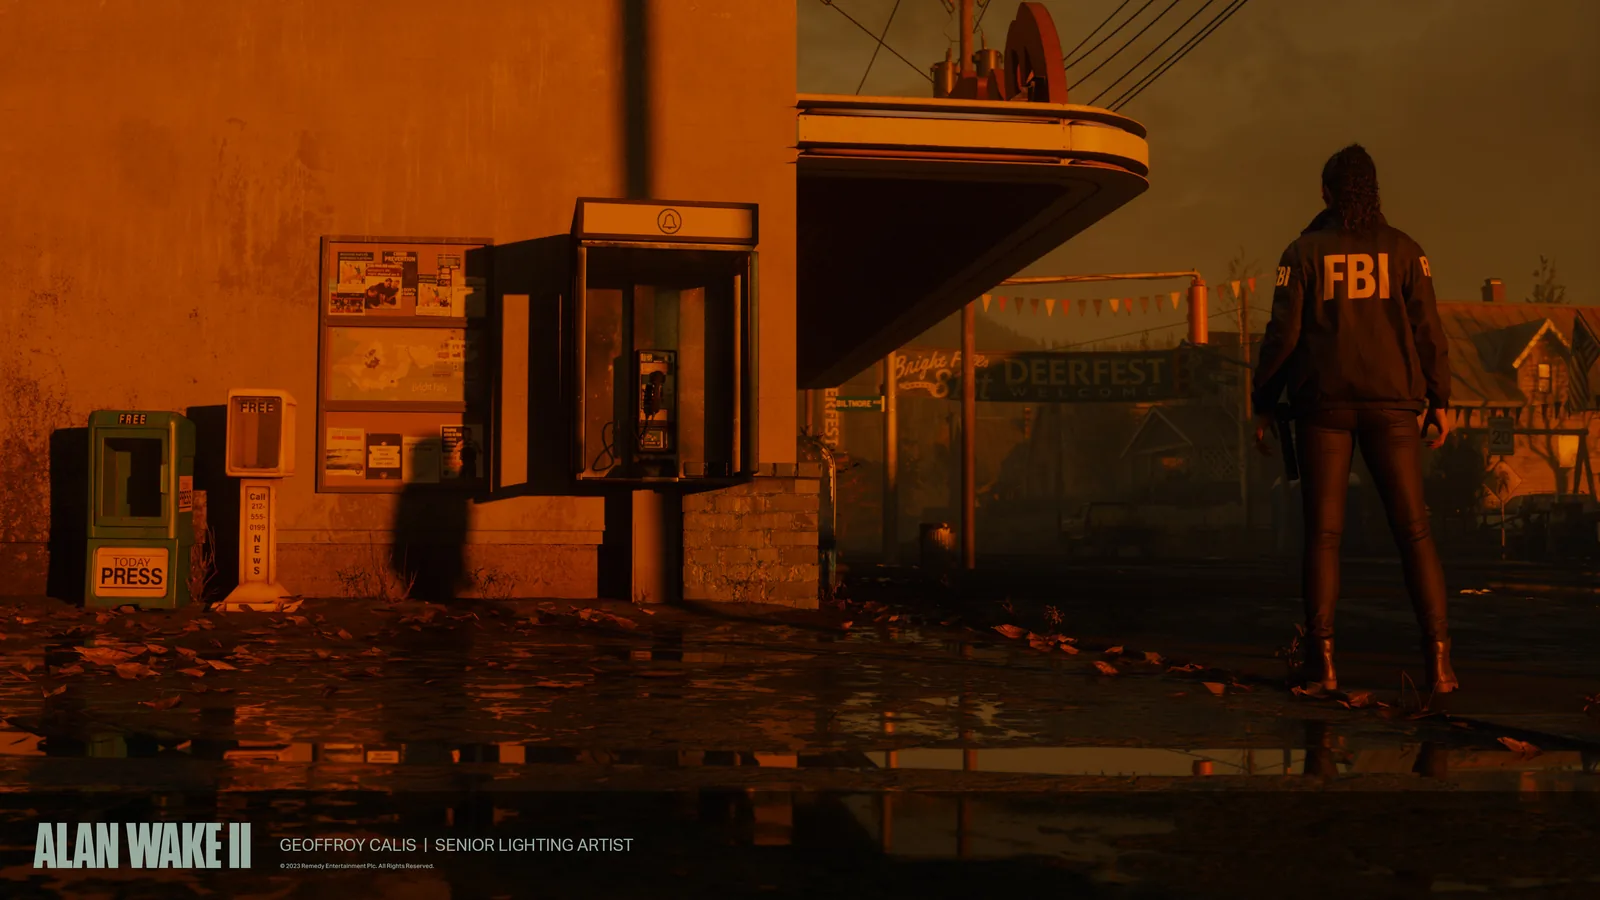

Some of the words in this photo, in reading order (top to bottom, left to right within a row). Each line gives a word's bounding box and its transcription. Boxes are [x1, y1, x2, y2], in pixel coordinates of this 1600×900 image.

[1275, 266, 1291, 286] BI
[1323, 253, 1390, 301] FBI
[895, 350, 947, 380] Bright
[1004, 358, 1165, 386] DEERFEST
[1009, 386, 1158, 398] WELCOME
[241, 402, 274, 413] FREE
[836, 399, 873, 408] BILTMORE
[119, 414, 147, 425] FREE
[1492, 430, 1511, 445] 20
[250, 493, 266, 501] Call
[113, 557, 151, 567] TODAY
[101, 567, 162, 585] PRESS
